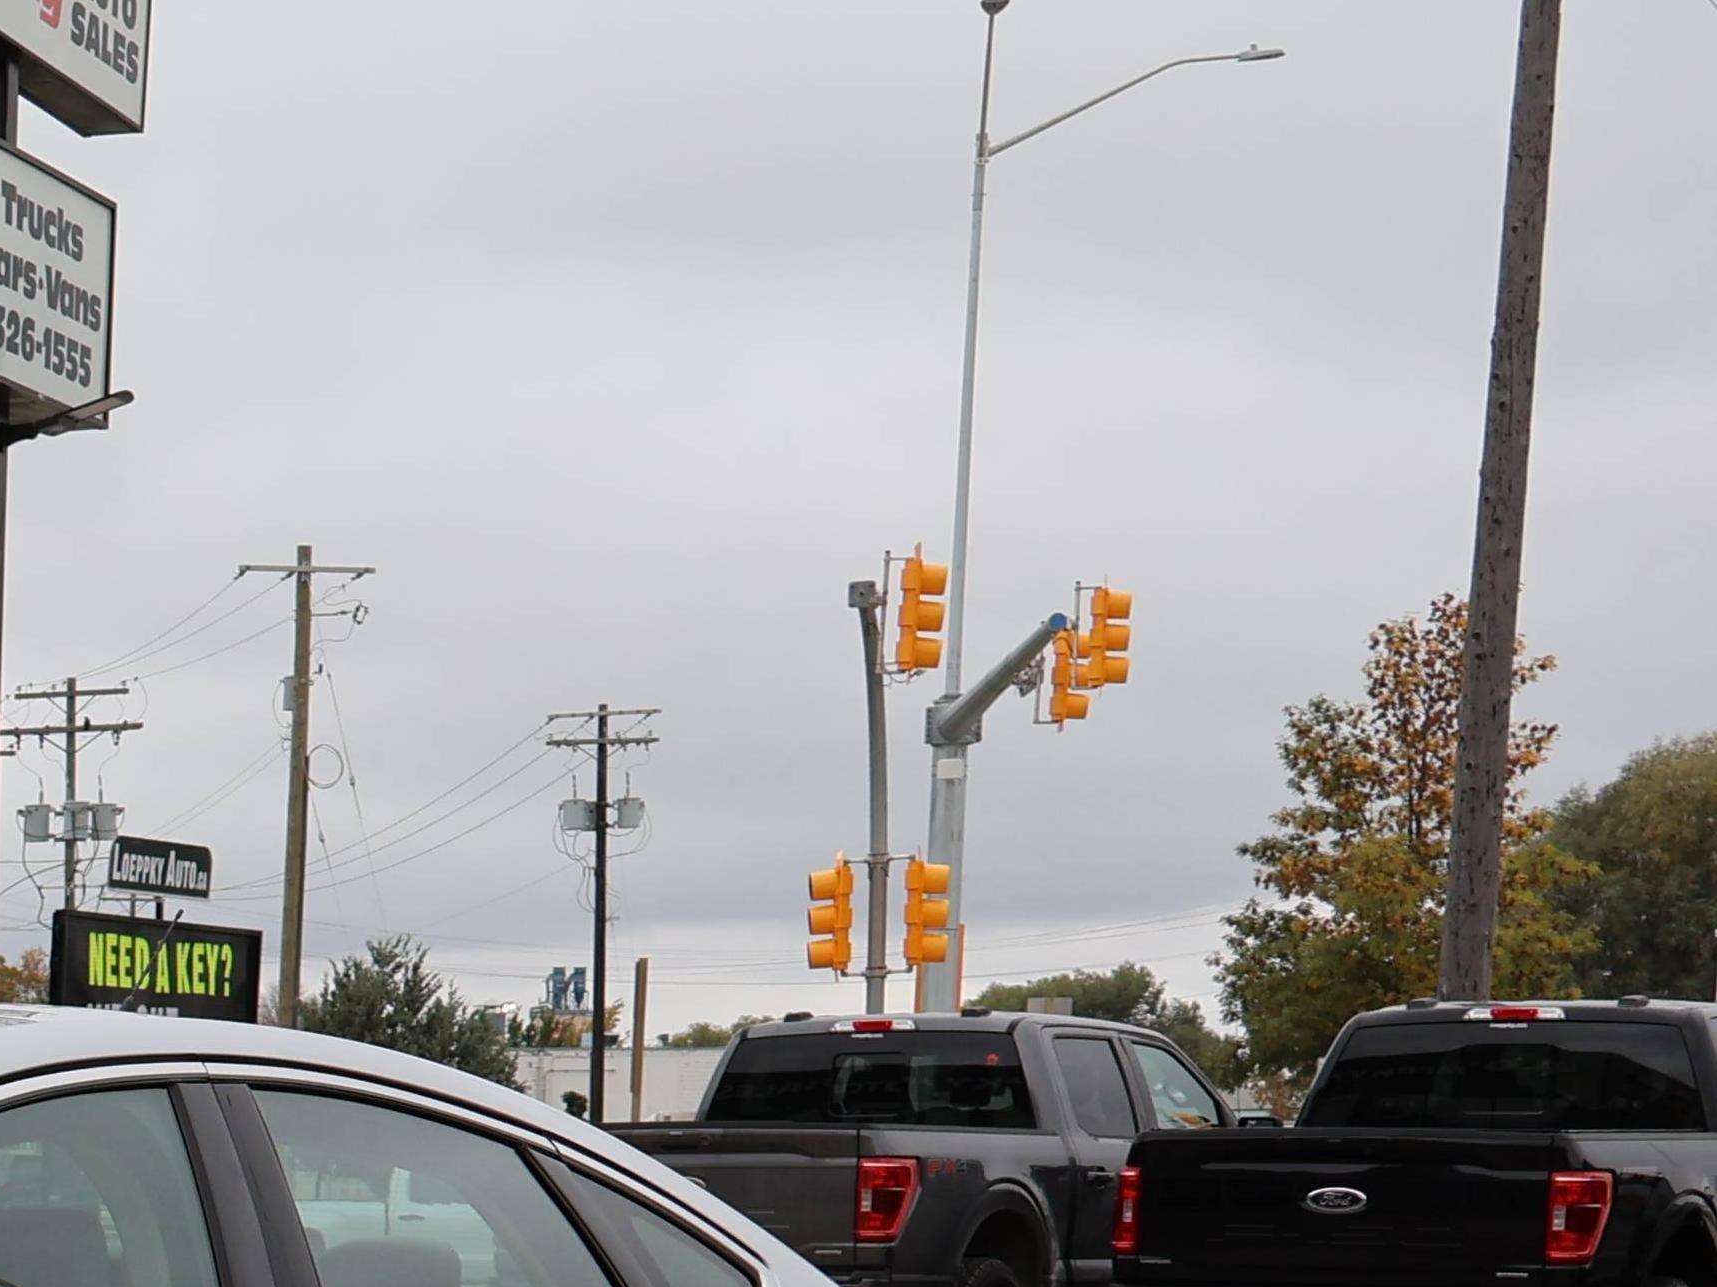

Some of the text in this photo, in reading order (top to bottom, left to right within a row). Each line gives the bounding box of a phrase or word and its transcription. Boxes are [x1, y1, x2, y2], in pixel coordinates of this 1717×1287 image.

[70, 2, 139, 85] SALES
[1, 179, 84, 263] Trucks
[88, 932, 234, 997] NEED A KEY?
[1319, 1191, 1353, 1207] Ford
